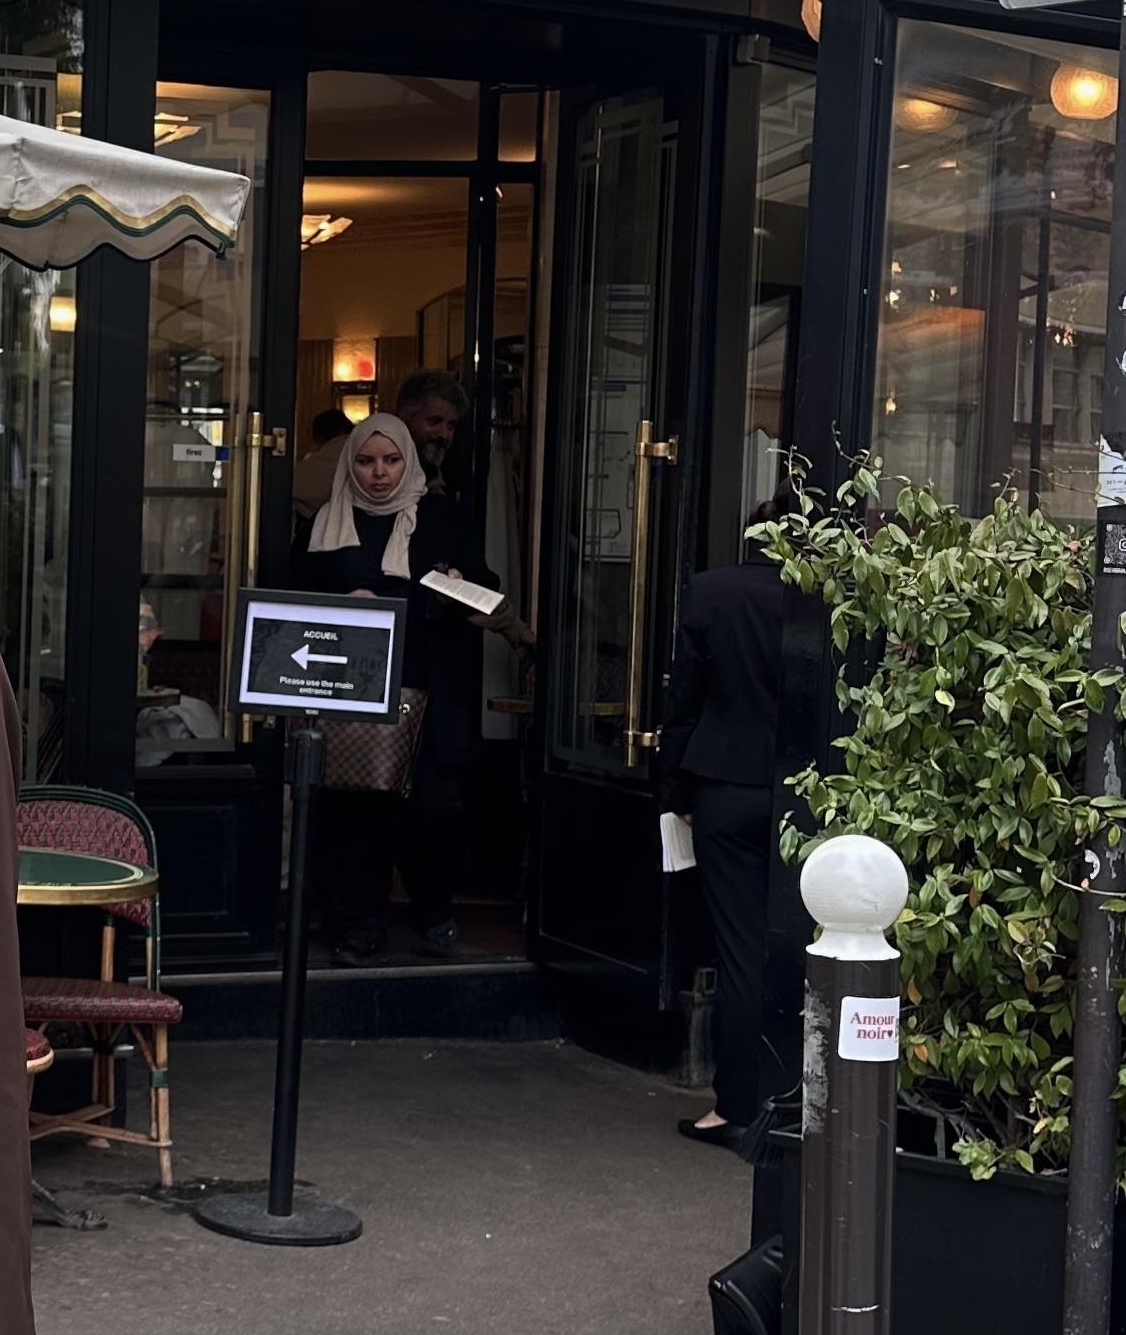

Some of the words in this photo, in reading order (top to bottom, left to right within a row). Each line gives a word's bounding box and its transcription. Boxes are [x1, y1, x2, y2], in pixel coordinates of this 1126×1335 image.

[303, 630, 339, 641] ACCUEIL
[279, 676, 305, 686] Please
[305, 679, 320, 687] use
[321, 679, 334, 688] the
[334, 682, 354, 690] main
[299, 687, 333, 696] entrance
[850, 1011, 895, 1025] Amour
[857, 1027, 888, 1039] noir
